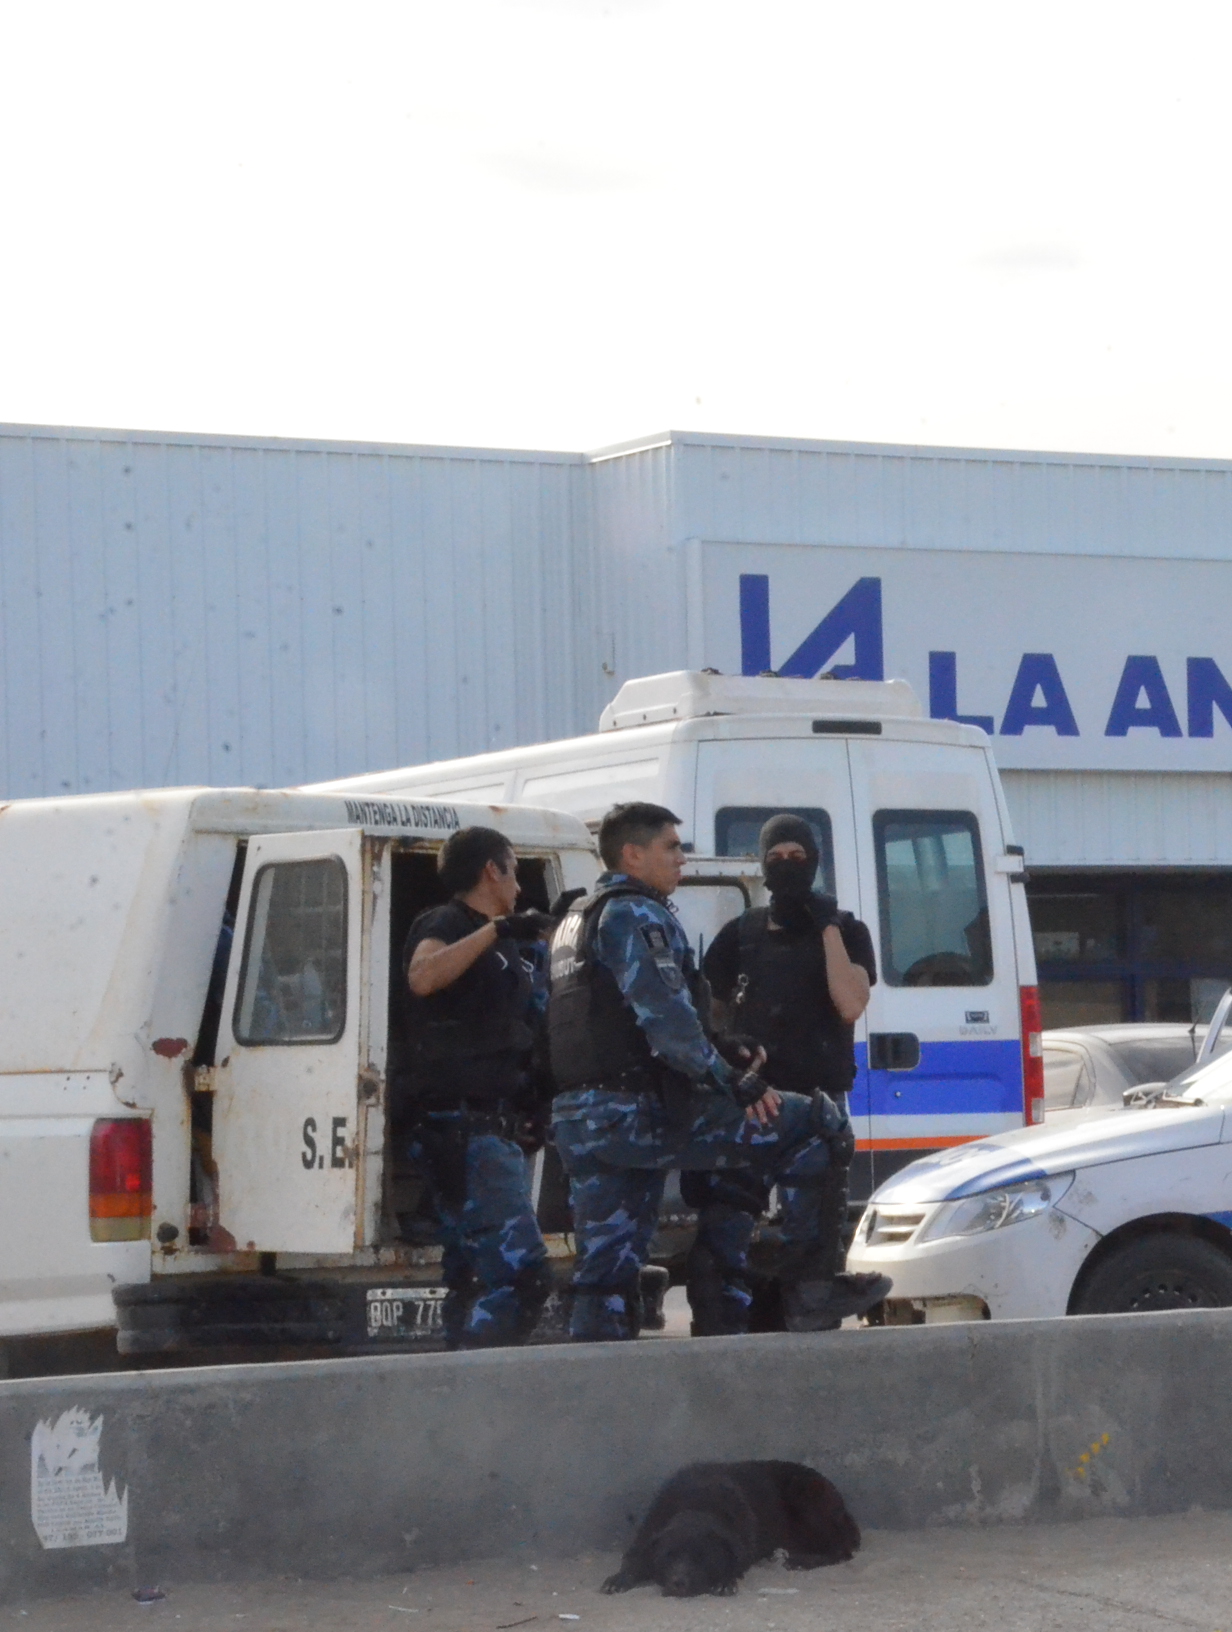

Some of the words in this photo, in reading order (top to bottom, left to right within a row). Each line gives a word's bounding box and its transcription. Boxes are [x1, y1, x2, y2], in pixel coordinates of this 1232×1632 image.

[928, 650, 1080, 737] LA
[345, 801, 399, 826] MANTENGA
[398, 804, 412, 827] LA
[411, 804, 460, 830] DISTANCIA
